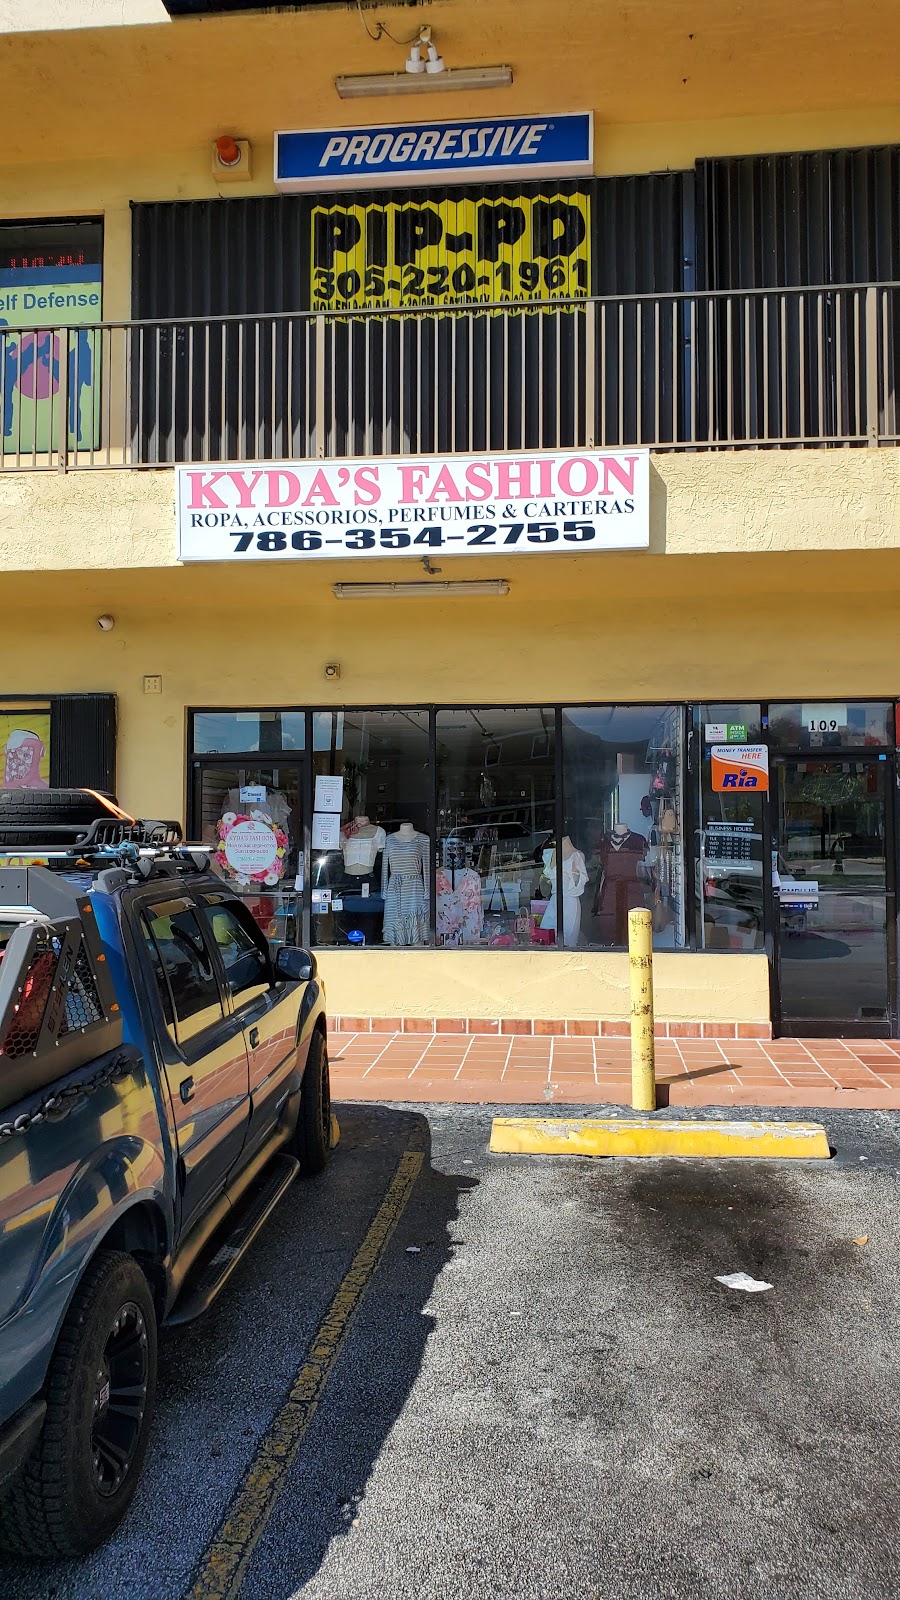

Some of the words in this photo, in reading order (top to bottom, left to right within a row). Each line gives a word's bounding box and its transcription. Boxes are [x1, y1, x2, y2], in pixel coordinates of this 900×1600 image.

[318, 124, 548, 168] PROGRESSIVE
[313, 199, 587, 270] PIP-PD
[313, 258, 588, 301] 305-220-1961
[24, 292, 99, 310] Defense
[186, 466, 382, 510] KYDA'S
[397, 456, 639, 504] FASHION
[190, 513, 249, 528] ROPA,
[253, 508, 383, 527] ACESSORIOS,
[388, 504, 496, 523] PERFUMES
[502, 503, 518, 519] &
[524, 499, 635, 518] CARTERAS
[229, 520, 596, 553] 786-354-2755
[810, 719, 837, 731] 109
[722, 768, 758, 788] Ria
